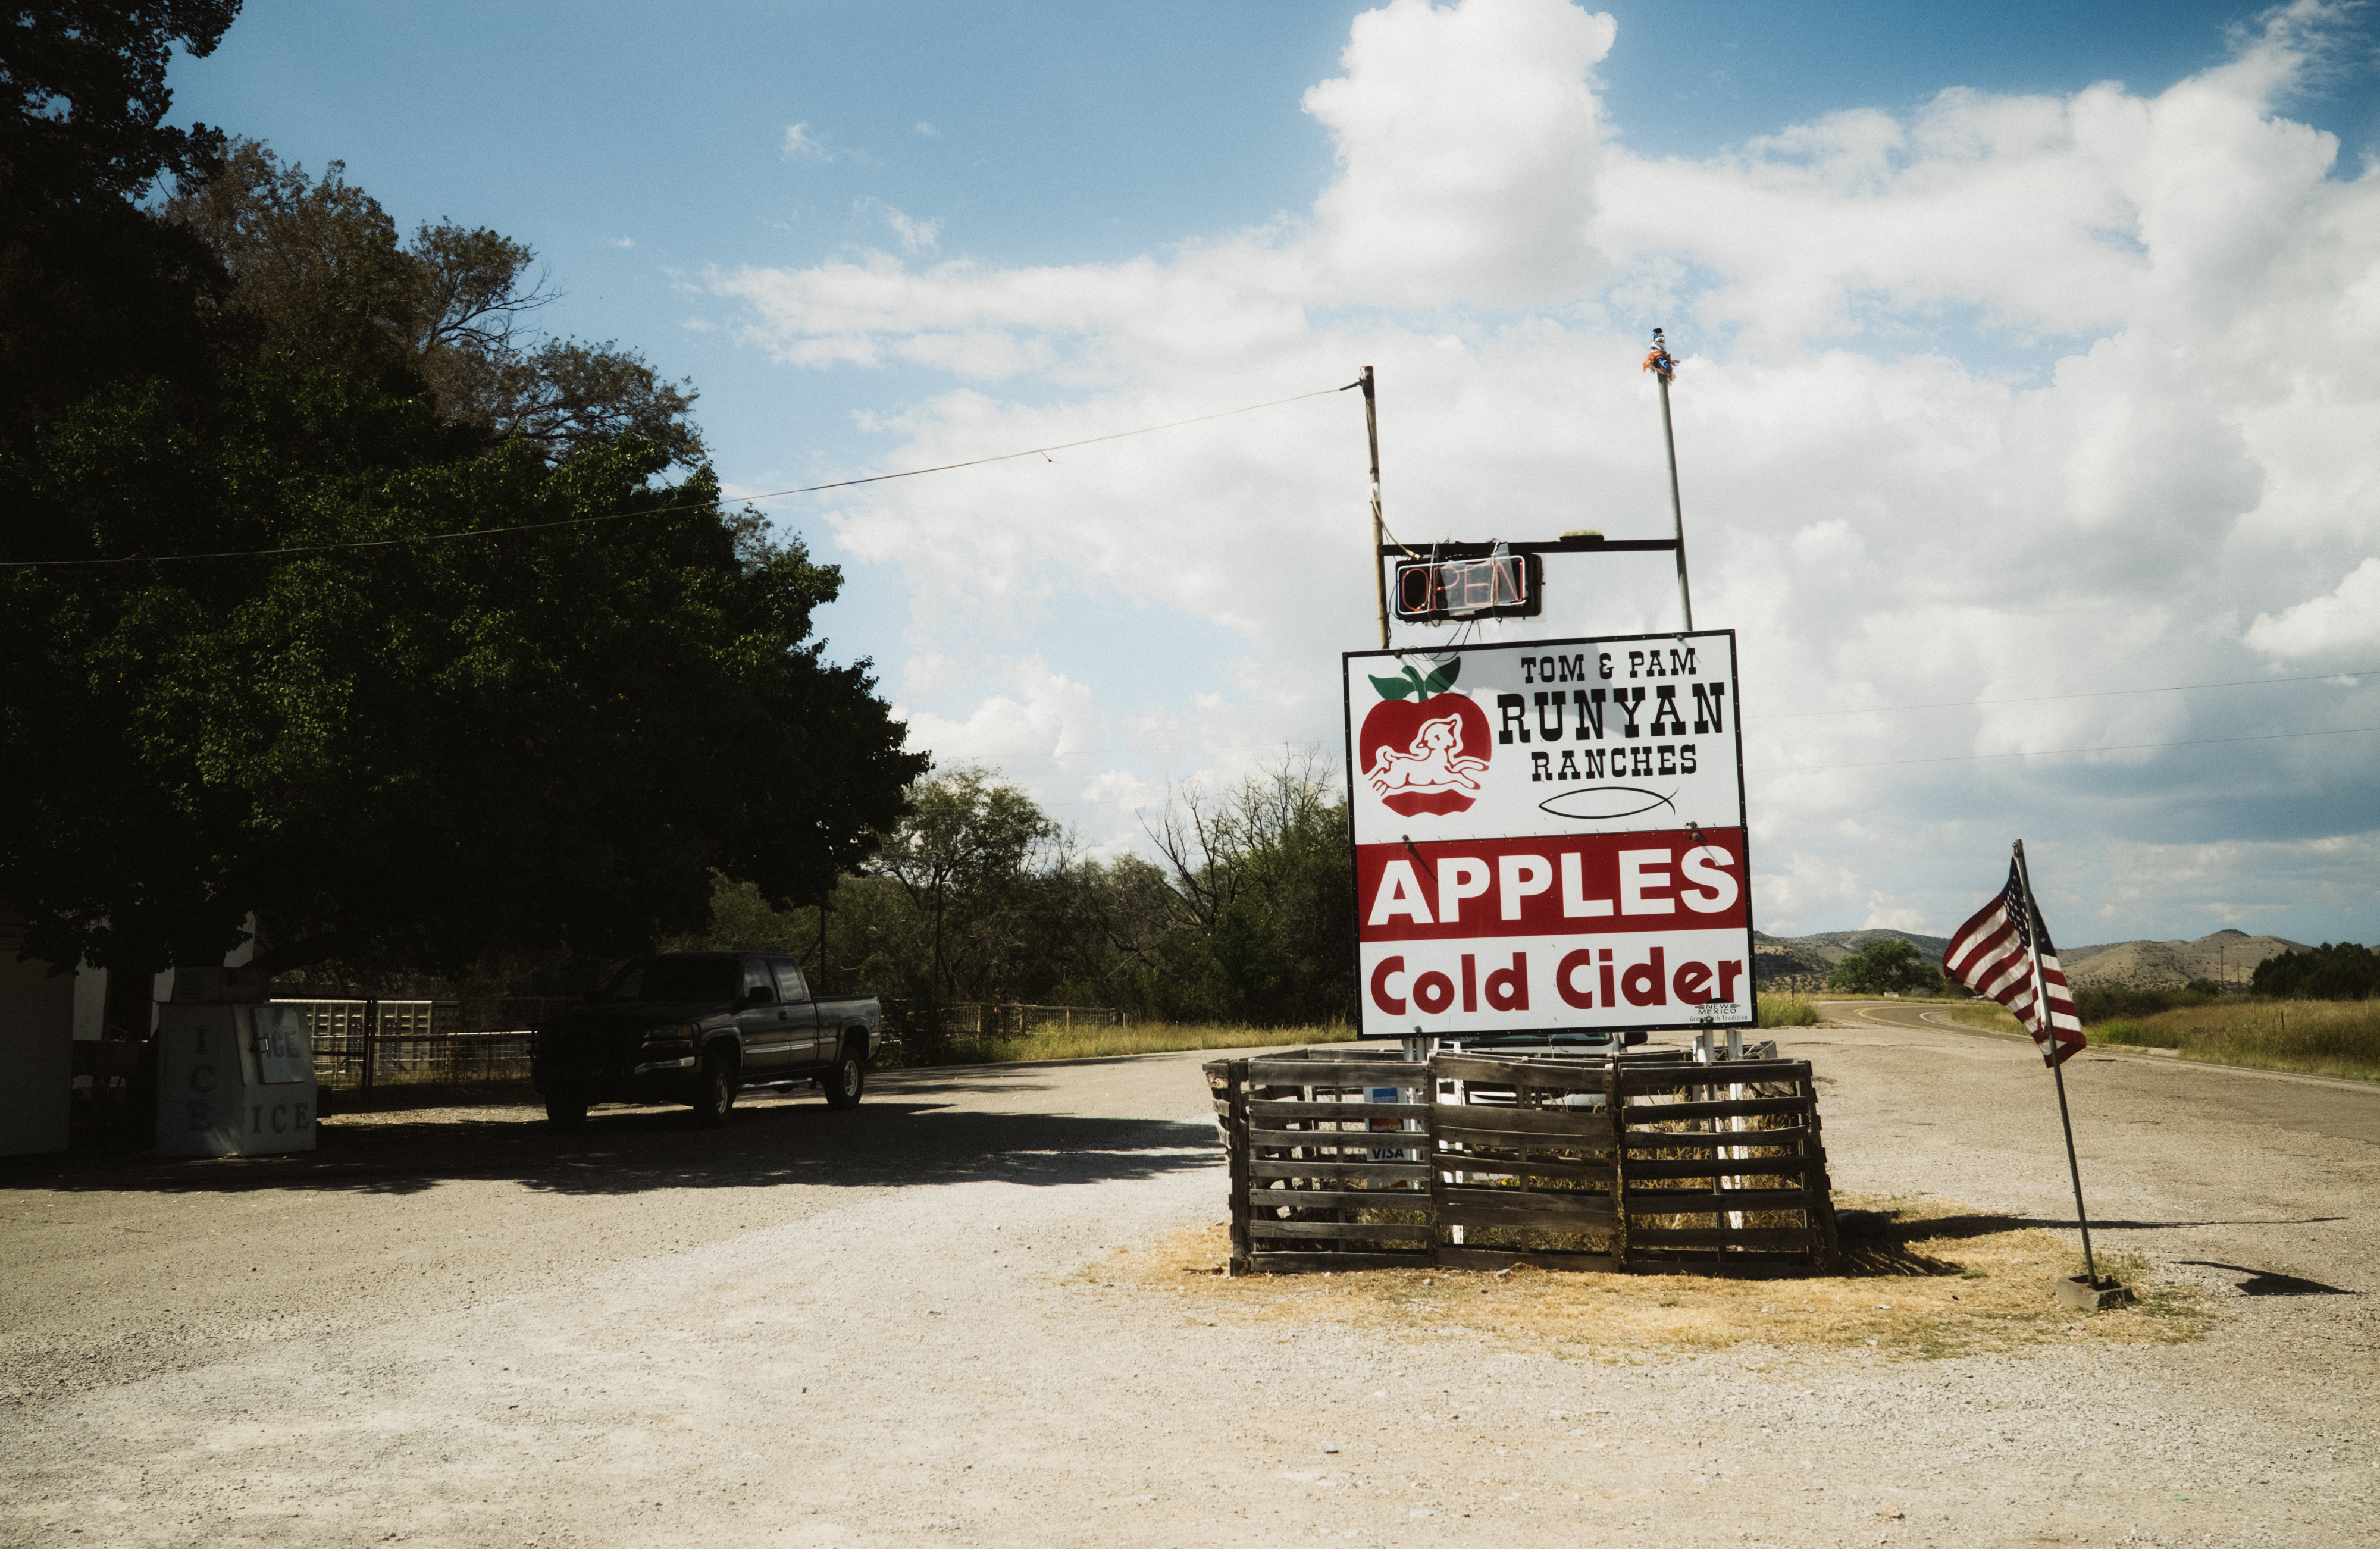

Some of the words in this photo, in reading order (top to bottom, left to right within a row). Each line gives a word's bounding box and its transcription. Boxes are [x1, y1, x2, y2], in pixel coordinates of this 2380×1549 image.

[1402, 561, 1523, 612] OPEN
[1521, 654, 1586, 684] TOM
[1598, 652, 1614, 680] &
[1629, 647, 1697, 678] PAM
[1497, 682, 1725, 745] RUNYAN
[1531, 744, 1697, 782] RANCHES
[1367, 845, 1739, 926] APPLES
[1370, 951, 1530, 1016] Cold
[1555, 946, 1743, 1010] Cider
[262, 1026, 300, 1058] ICE
[186, 1026, 214, 1133] ICE
[252, 1102, 311, 1134] ICE
[1372, 1148, 1404, 1159] VISA
